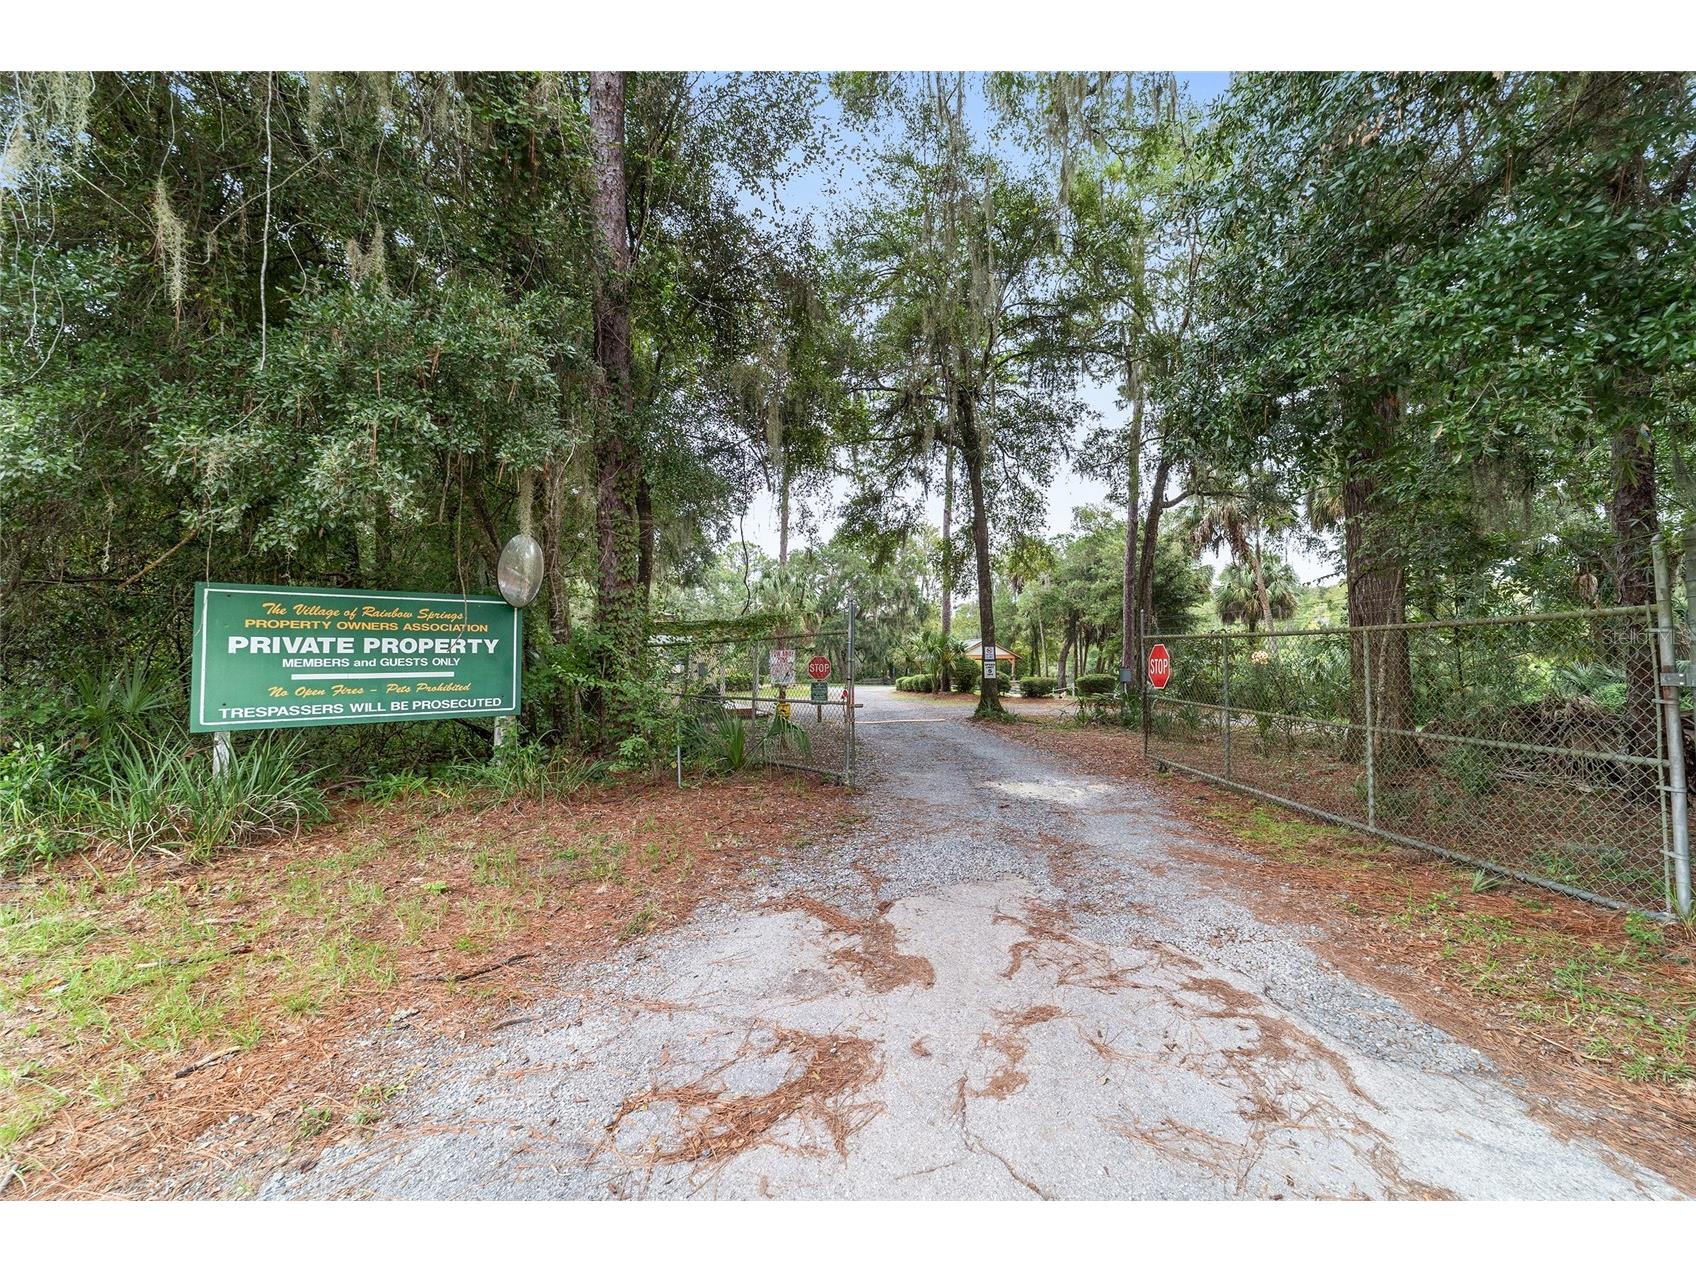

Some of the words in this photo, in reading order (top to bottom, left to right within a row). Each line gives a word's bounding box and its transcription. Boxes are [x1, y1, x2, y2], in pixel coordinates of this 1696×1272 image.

[262, 602, 288, 616] The
[293, 603, 340, 618] Village
[343, 606, 358, 619] of
[361, 606, 413, 619] Rainbow
[418, 609, 463, 620] Springs
[245, 620, 332, 630] PROPERTY
[337, 621, 398, 631] OWNERS
[403, 623, 488, 632] ASSOCIATION
[228, 636, 354, 654] PRIVATE
[364, 638, 499, 653] PROPERTY
[282, 658, 348, 667] MEMBERS
[354, 658, 376, 666] and
[380, 657, 428, 666] GUESTS
[432, 657, 460, 666] ONLY
[809, 664, 829, 673] STOP
[1150, 658, 1168, 674] STOP
[268, 686, 288, 697] No
[295, 686, 325, 697] Open
[332, 684, 364, 695] Fires
[386, 683, 410, 694] Pets
[416, 683, 471, 693] Prohibited
[219, 703, 343, 719] TRESPASSERS
[349, 702, 386, 712] WILL
[390, 701, 409, 711] BE
[413, 697, 501, 710] PROSECUTED
